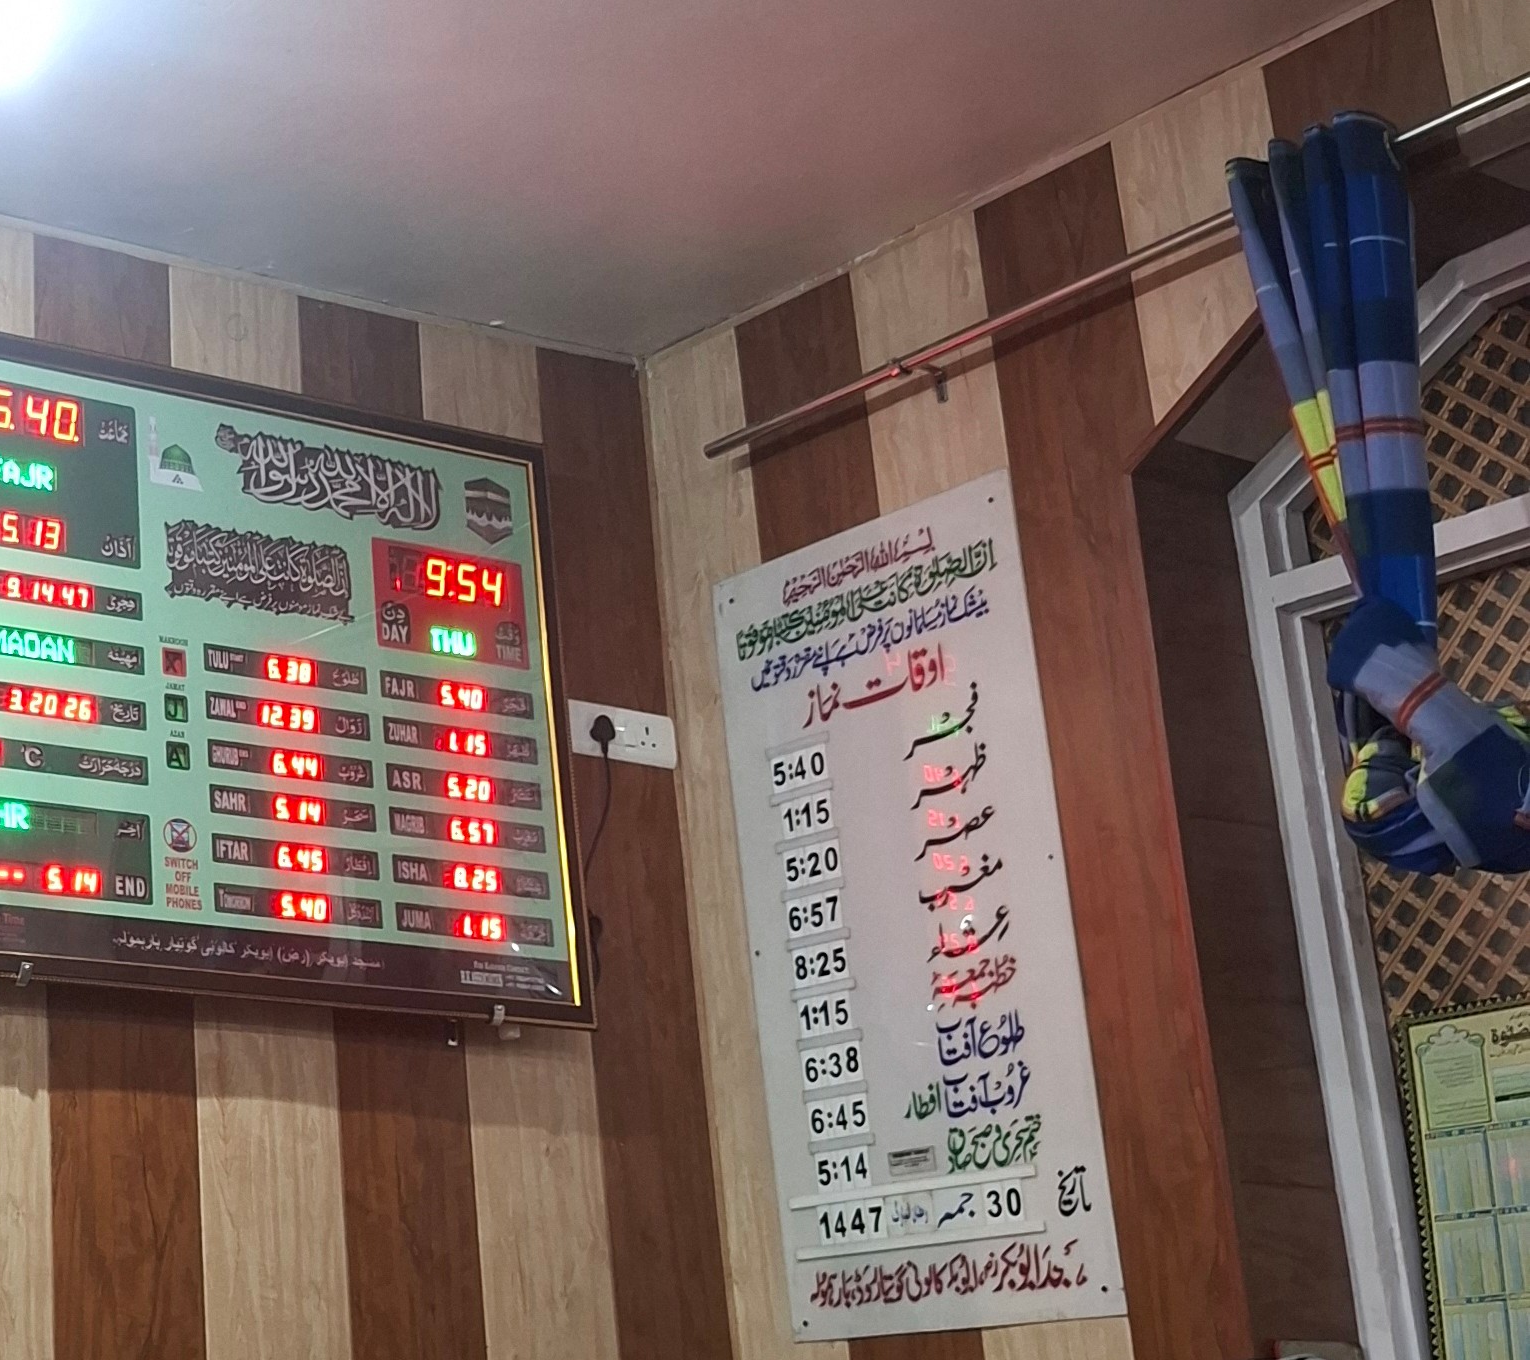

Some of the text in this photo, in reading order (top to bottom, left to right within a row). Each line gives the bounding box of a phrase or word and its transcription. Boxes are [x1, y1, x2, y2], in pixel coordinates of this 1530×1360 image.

[426, 559, 503, 606] 9:54
[382, 624, 408, 643] DAY
[431, 628, 475, 657] THU
[208, 649, 229, 669] TULU
[496, 645, 522, 661] TIME
[385, 676, 414, 699] FAJR
[388, 722, 418, 745] ZUHAR
[392, 769, 422, 790] ASR
[773, 752, 824, 786] 5:40
[214, 791, 246, 812] SAHR
[783, 798, 829, 832] 1:15
[216, 839, 248, 861] IFTAR
[164, 857, 198, 870] SWITCH
[397, 860, 428, 882] ISHA
[786, 847, 838, 882] 5:20
[115, 875, 146, 896] END
[175, 871, 191, 882] OFF
[166, 884, 199, 897] MOBILE
[166, 897, 202, 911] PHONES
[788, 896, 838, 931] 6:57
[401, 909, 432, 930] JUMA
[795, 947, 846, 980] 8:25
[800, 999, 849, 1030] 1:15
[805, 1047, 859, 1082] 6:38
[811, 1101, 866, 1134] 6:45
[818, 1153, 867, 1186] 5:14
[986, 1187, 1021, 1218] 30
[819, 1206, 882, 1239] 1447
